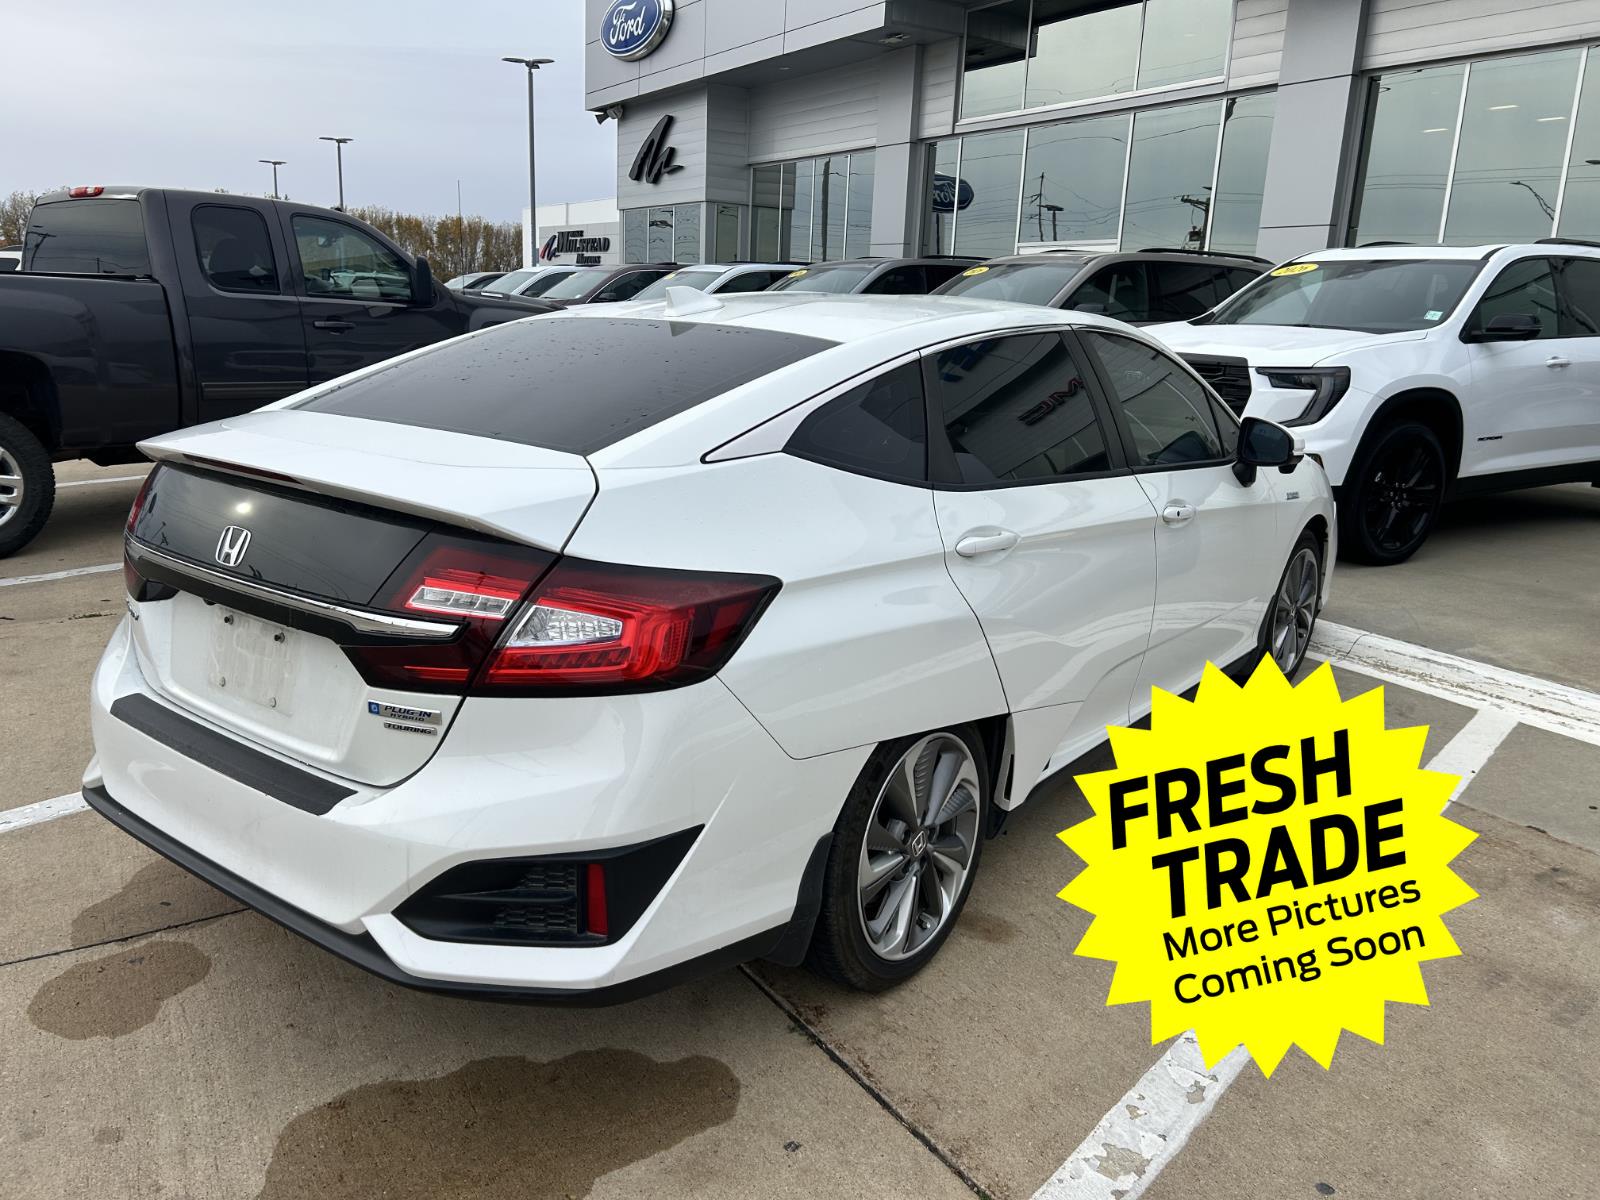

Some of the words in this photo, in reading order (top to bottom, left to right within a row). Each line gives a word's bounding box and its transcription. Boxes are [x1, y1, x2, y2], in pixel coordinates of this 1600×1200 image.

[610, 1, 646, 45] Ford
[384, 704, 433, 718] PLUG-IN
[385, 722, 432, 735] TOURING
